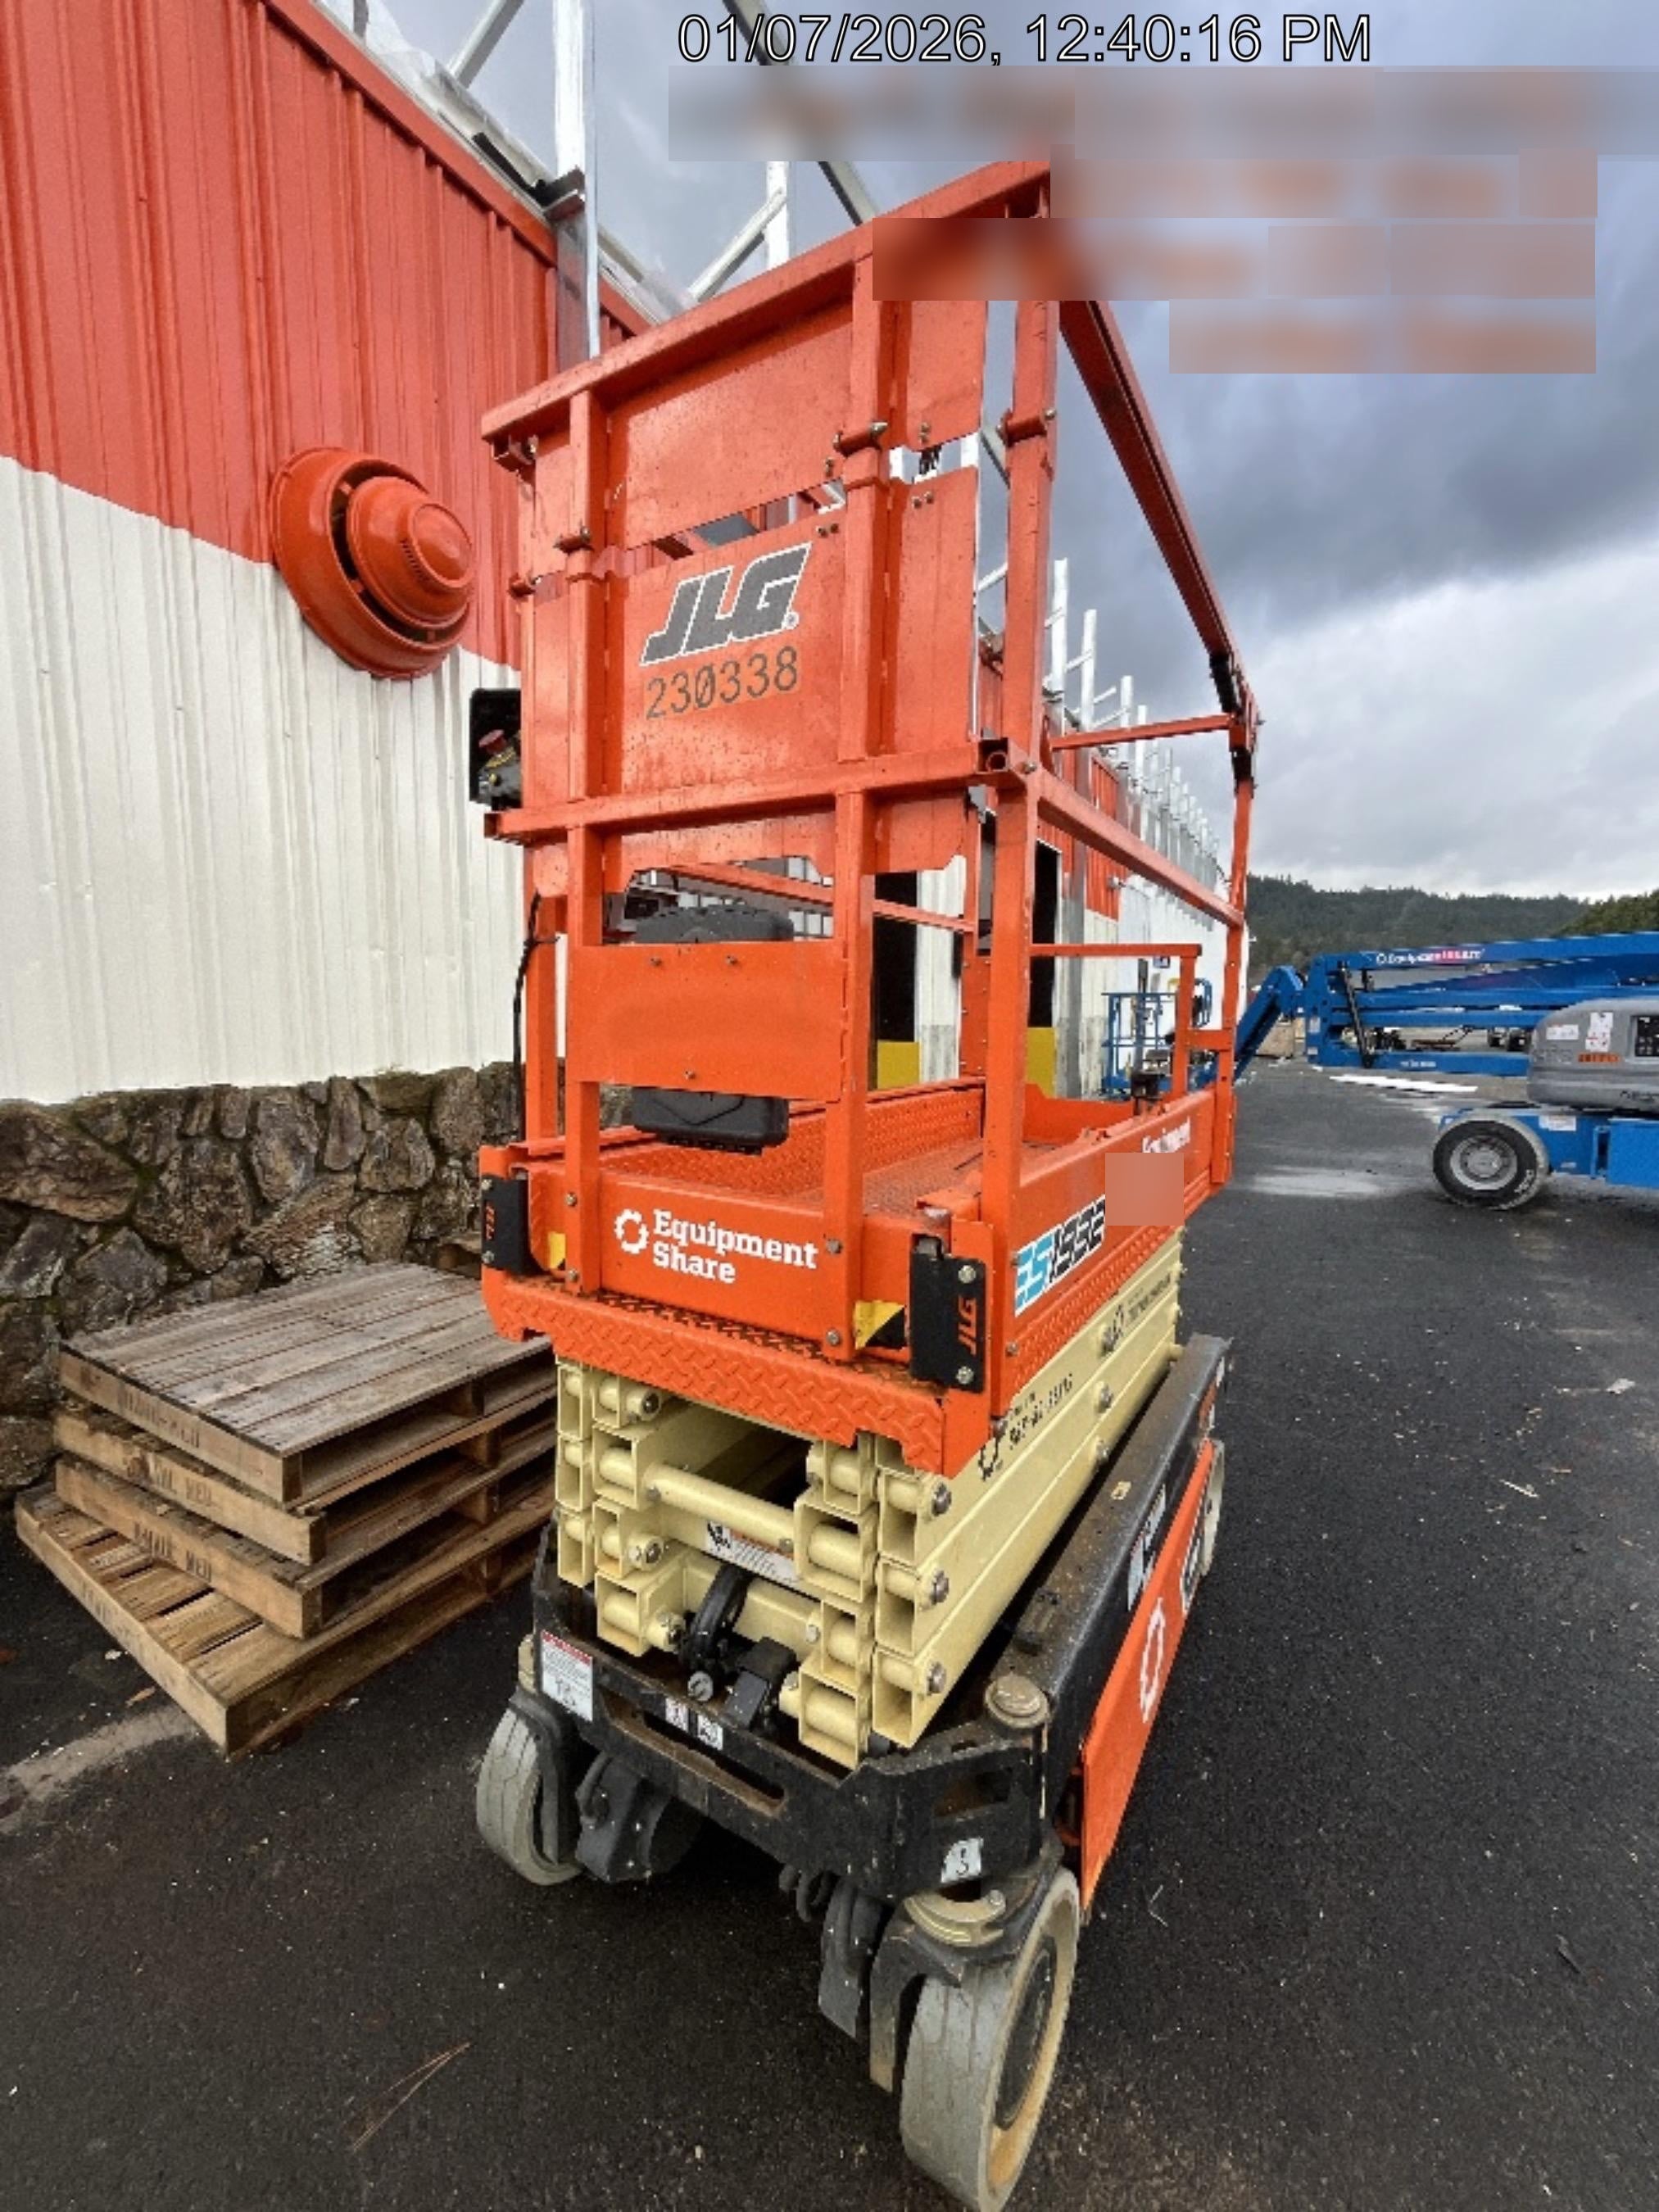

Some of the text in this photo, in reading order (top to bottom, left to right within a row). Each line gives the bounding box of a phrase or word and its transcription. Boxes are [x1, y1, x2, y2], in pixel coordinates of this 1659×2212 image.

[639, 542, 812, 667] JLG
[646, 646, 798, 719] 230338
[653, 1208, 818, 1269] Equipment
[653, 1241, 736, 1284] Share
[958, 1294, 977, 1356] JLG
